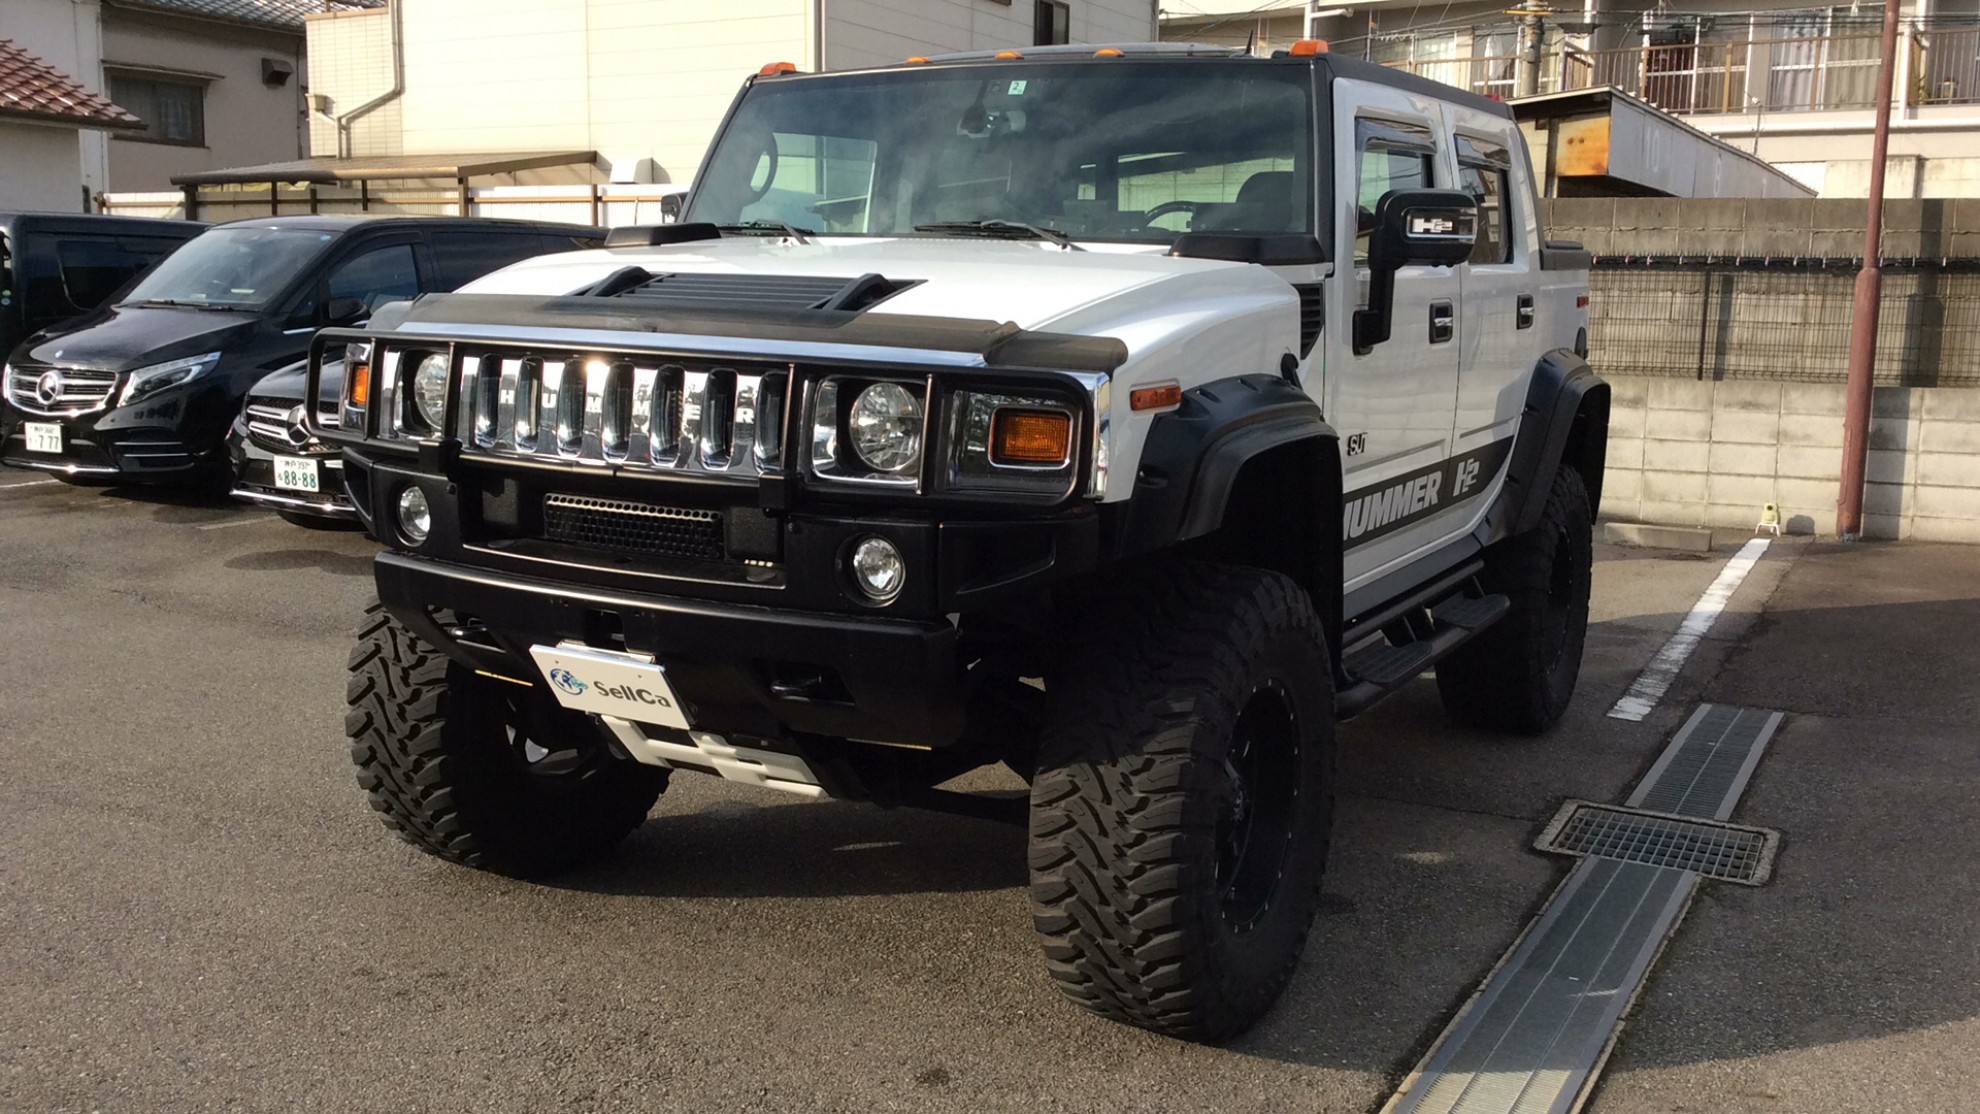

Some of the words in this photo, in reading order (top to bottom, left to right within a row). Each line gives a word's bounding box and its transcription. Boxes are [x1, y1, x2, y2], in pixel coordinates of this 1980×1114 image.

[1412, 217, 1454, 234] H2
[500, 388, 756, 424] HUMMER
[283, 469, 317, 489] 88-88
[593, 680, 672, 708] SellCa
